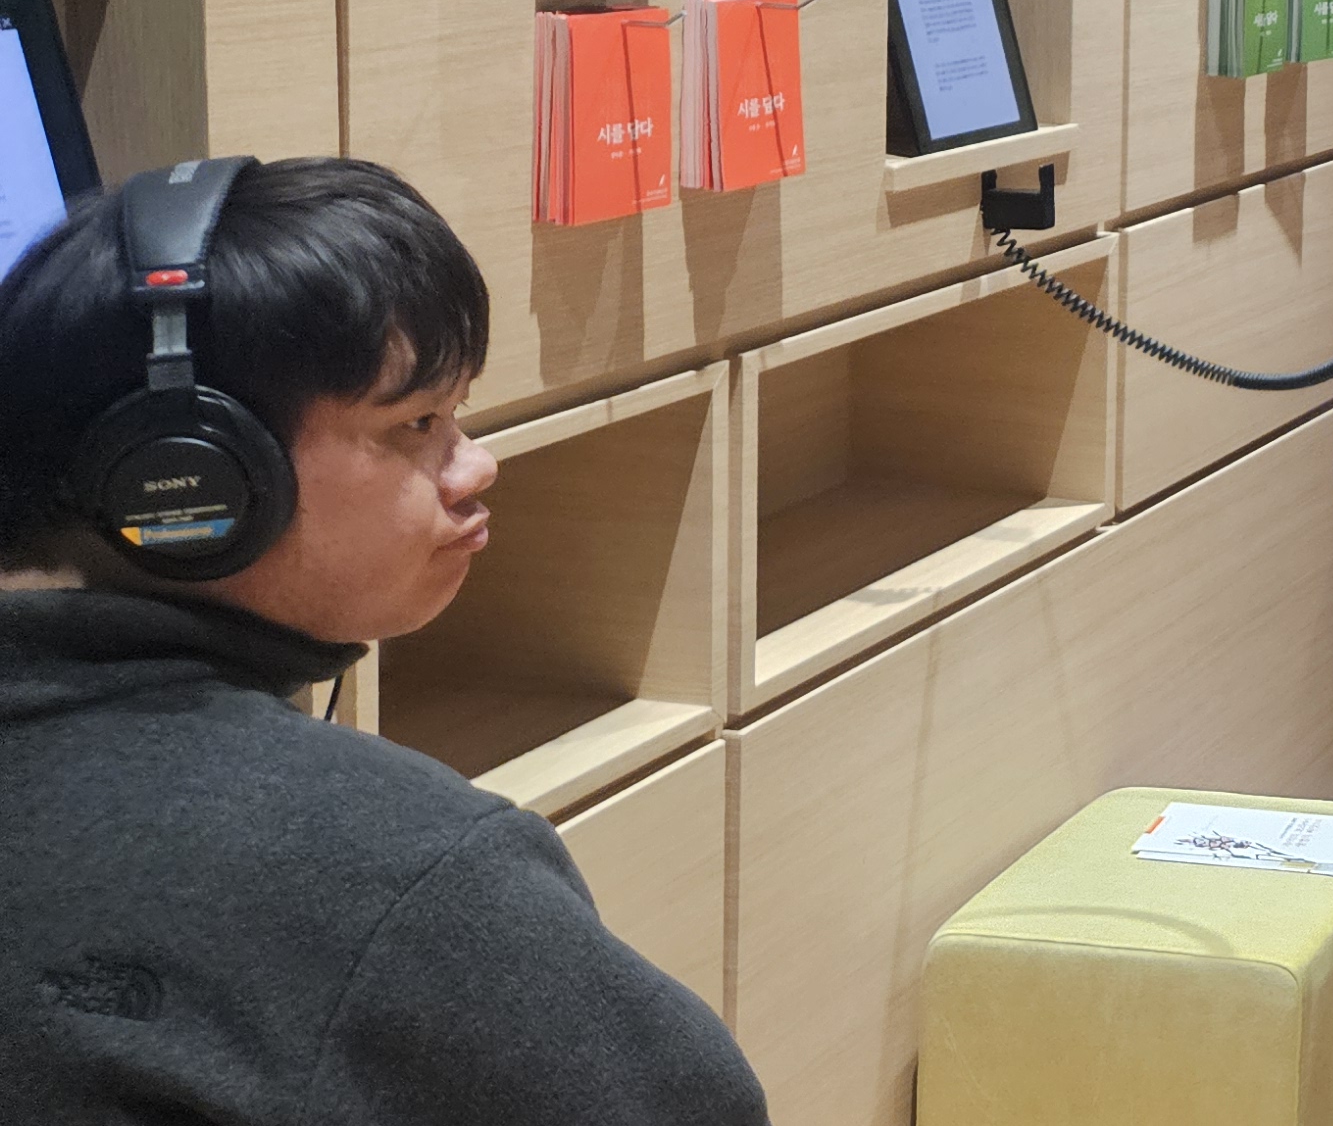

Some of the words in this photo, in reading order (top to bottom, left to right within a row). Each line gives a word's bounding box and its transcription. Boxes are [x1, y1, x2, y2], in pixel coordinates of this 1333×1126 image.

[737, 98, 761, 119] 시를
[761, 91, 786, 115] 담다
[597, 123, 626, 146] 시를
[626, 117, 654, 141] 담다
[143, 475, 201, 493] SONY
